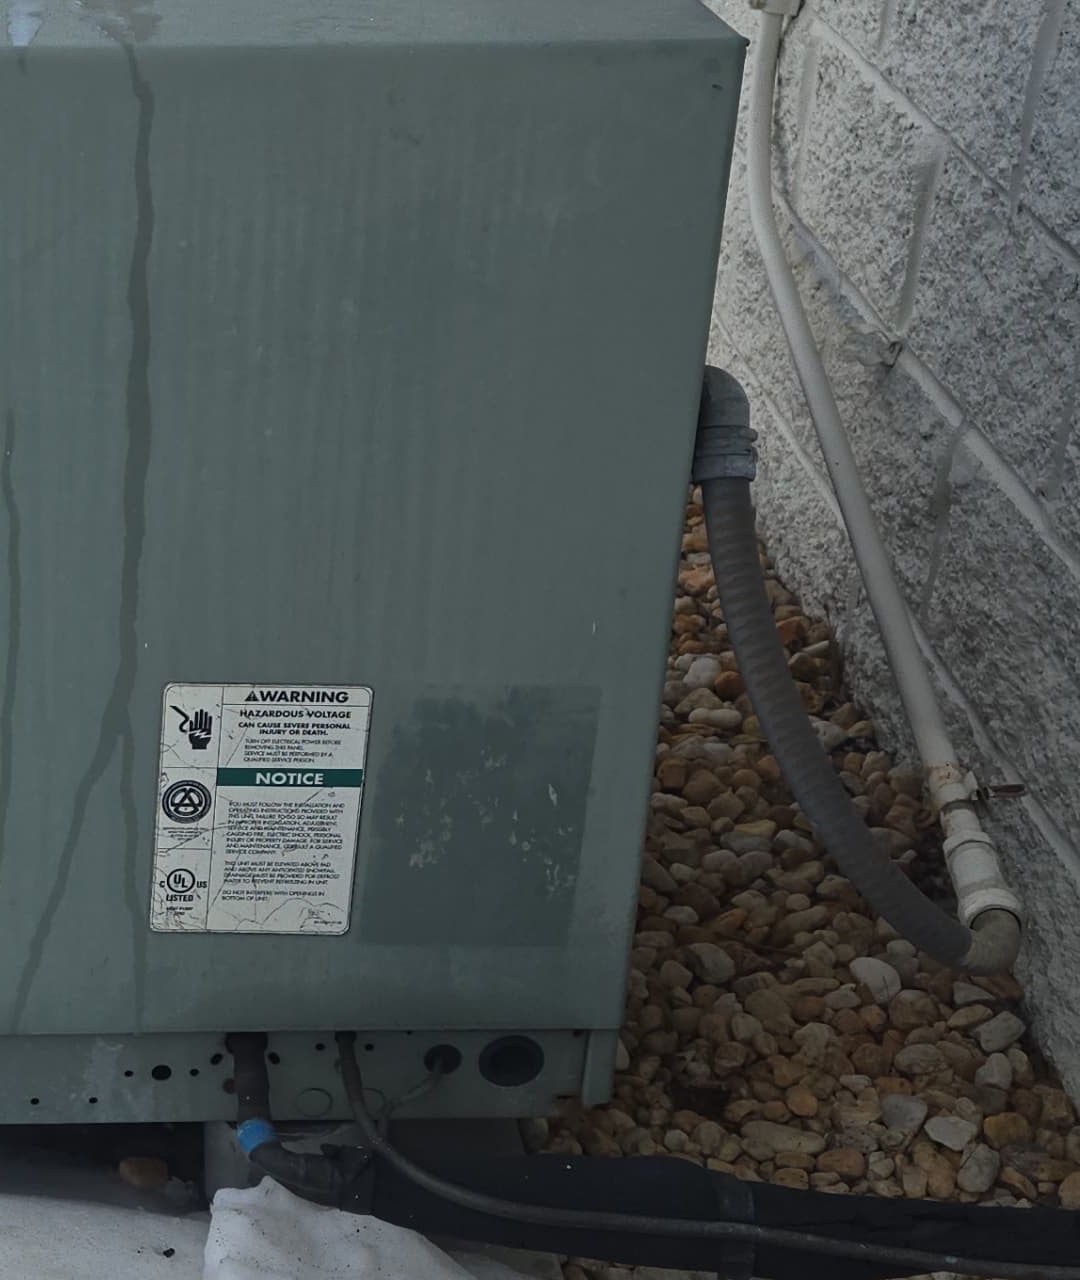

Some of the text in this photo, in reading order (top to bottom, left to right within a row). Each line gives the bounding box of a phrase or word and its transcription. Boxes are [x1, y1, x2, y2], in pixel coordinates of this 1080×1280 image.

[260, 690, 349, 703] WARNING
[240, 709, 351, 719] HAZARDOUS VOLTAGE
[255, 772, 324, 785] NOTICE
[173, 874, 188, 888] UL
[196, 880, 208, 888] US
[166, 894, 194, 902] LISTED
